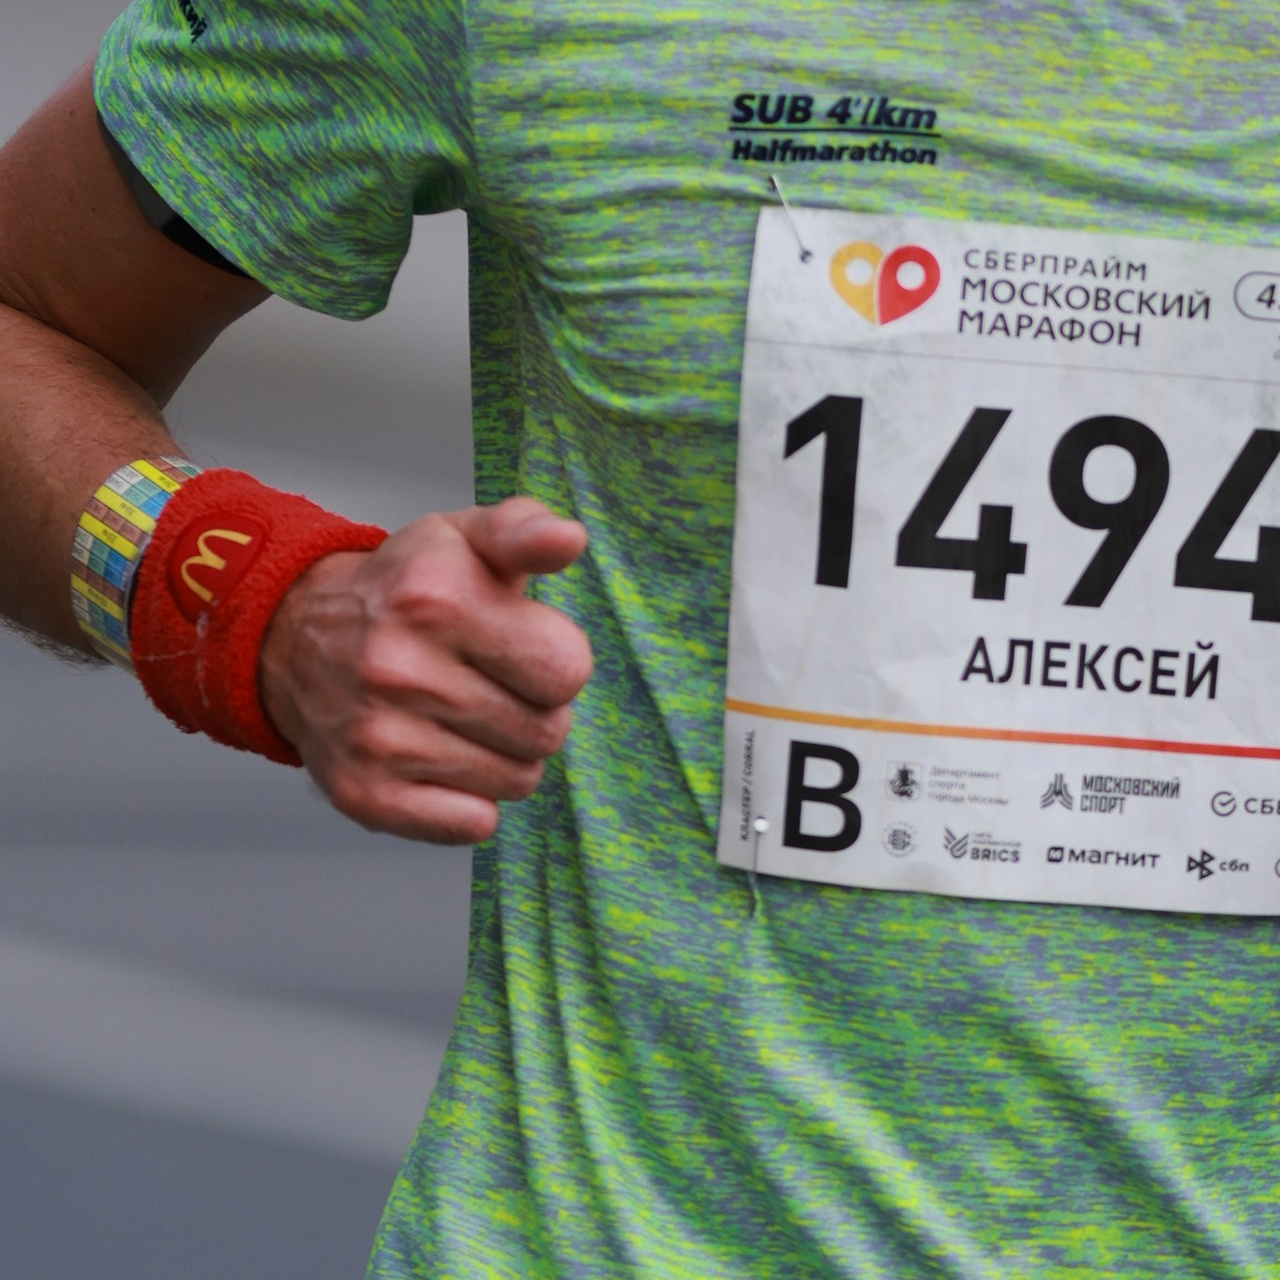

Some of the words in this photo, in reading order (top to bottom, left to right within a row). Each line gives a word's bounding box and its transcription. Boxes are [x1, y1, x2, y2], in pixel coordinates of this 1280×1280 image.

[731, 92, 814, 125] SUB
[826, 96, 938, 130] 4'/km
[731, 138, 938, 165] Halfmarathon
[963, 248, 1147, 281] СБЕРПРАЙМ
[960, 276, 1211, 321] МОСКОВСКИЙ
[957, 309, 1142, 347] МАРАФОН
[960, 636, 1222, 700] АЛЕКСЕЙ
[1081, 774, 1181, 799] МОСКОВСКИЙ
[1079, 794, 1126, 814] СПОРТ
[970, 847, 1021, 863] BRICS
[1068, 848, 1161, 868] магнит
[1219, 858, 1250, 872] сбп
